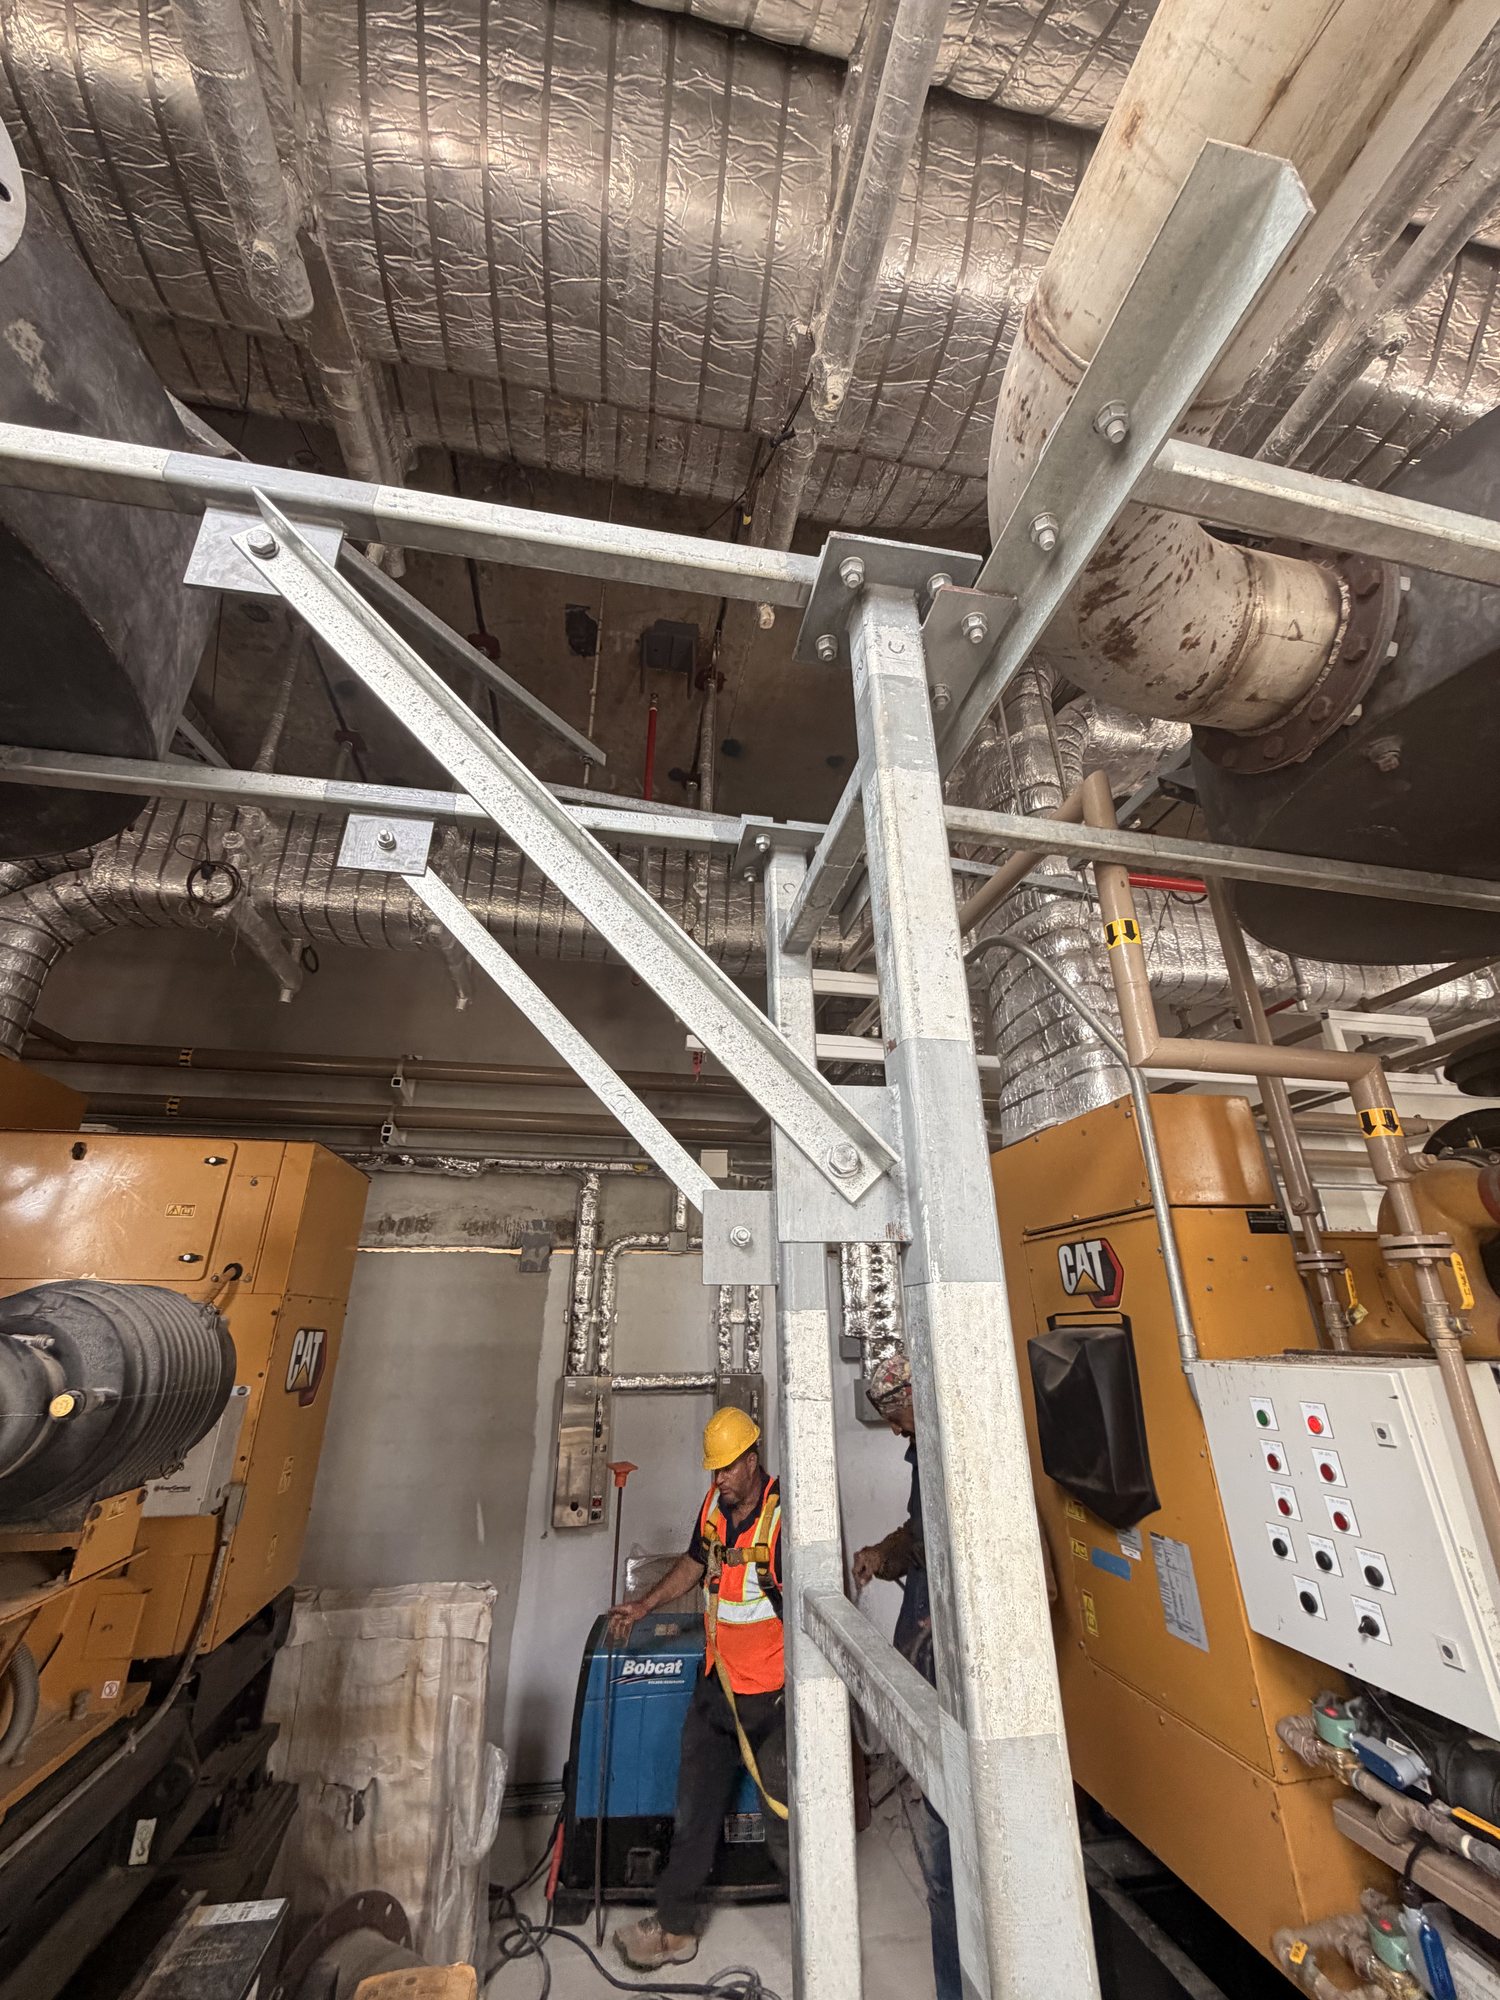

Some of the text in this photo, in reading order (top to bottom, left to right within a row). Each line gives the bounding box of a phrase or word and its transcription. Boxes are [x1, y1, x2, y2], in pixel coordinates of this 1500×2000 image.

[1058, 1240, 1106, 1294] CAT
[285, 1329, 325, 1391] CAT
[622, 1659, 683, 1675] Bobcat
